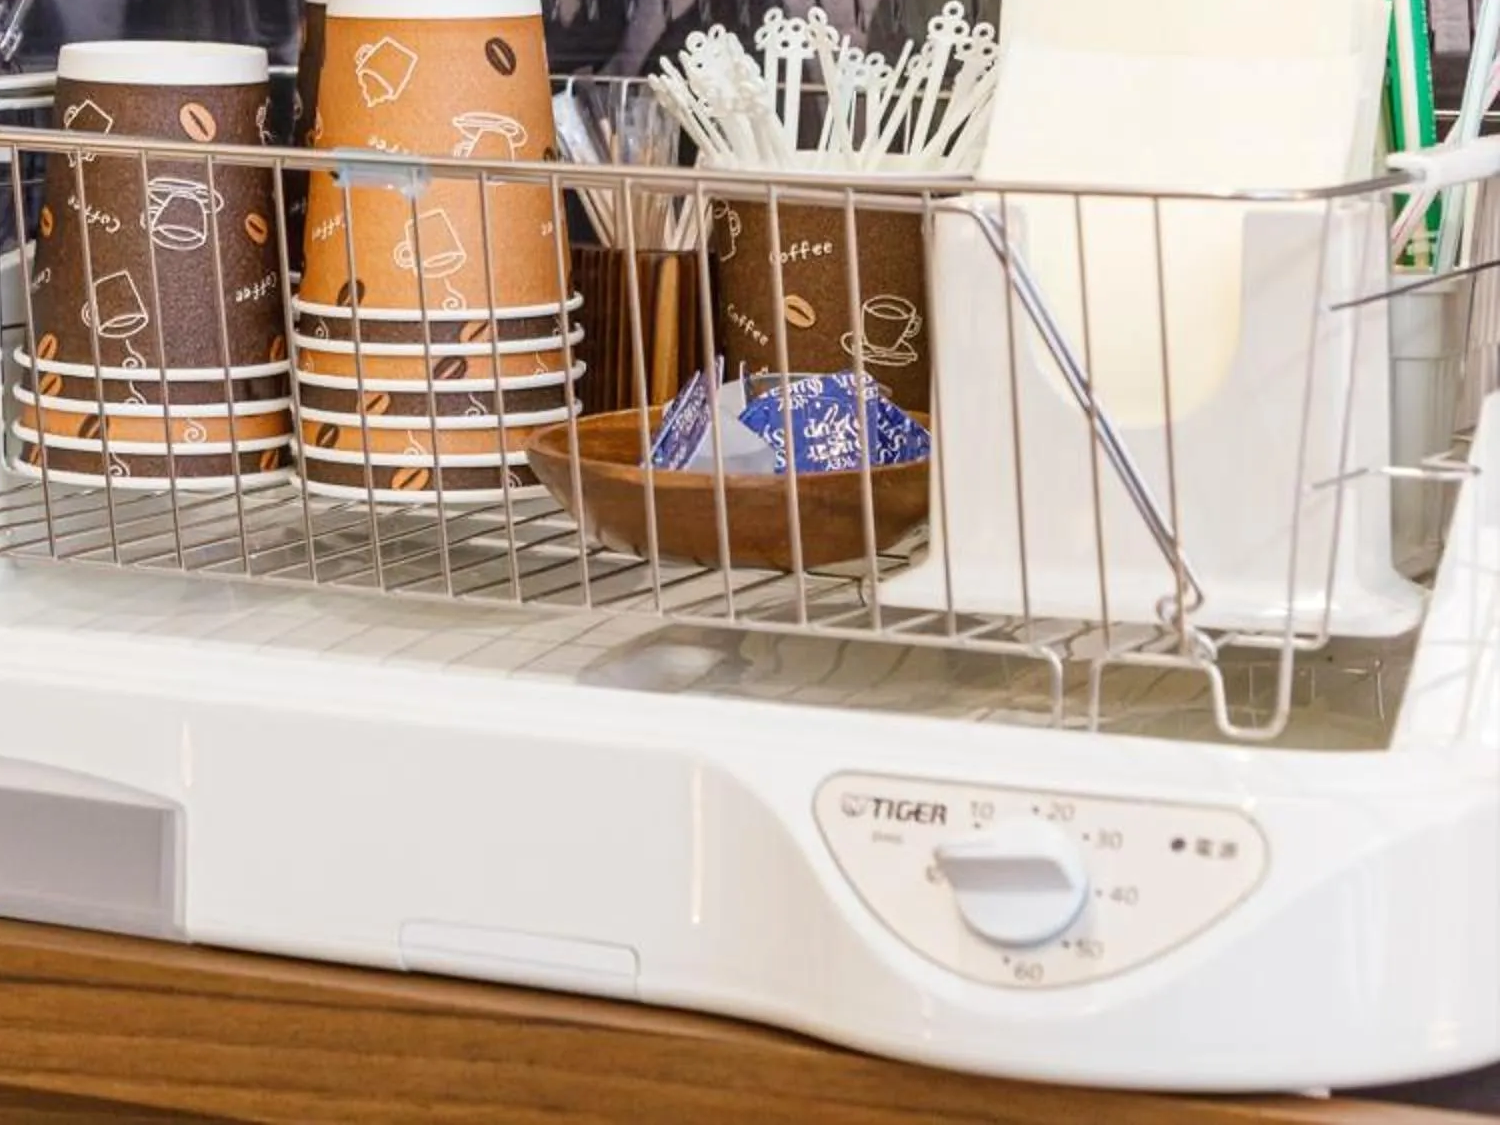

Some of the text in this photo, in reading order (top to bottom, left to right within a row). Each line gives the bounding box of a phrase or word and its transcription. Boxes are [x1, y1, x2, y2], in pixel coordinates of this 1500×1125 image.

[872, 797, 948, 825] TIGER
[970, 801, 995, 820] 10
[1047, 802, 1076, 823] 20
[1096, 831, 1124, 851] 30
[1109, 886, 1140, 907] 40
[1014, 963, 1045, 983] 60
